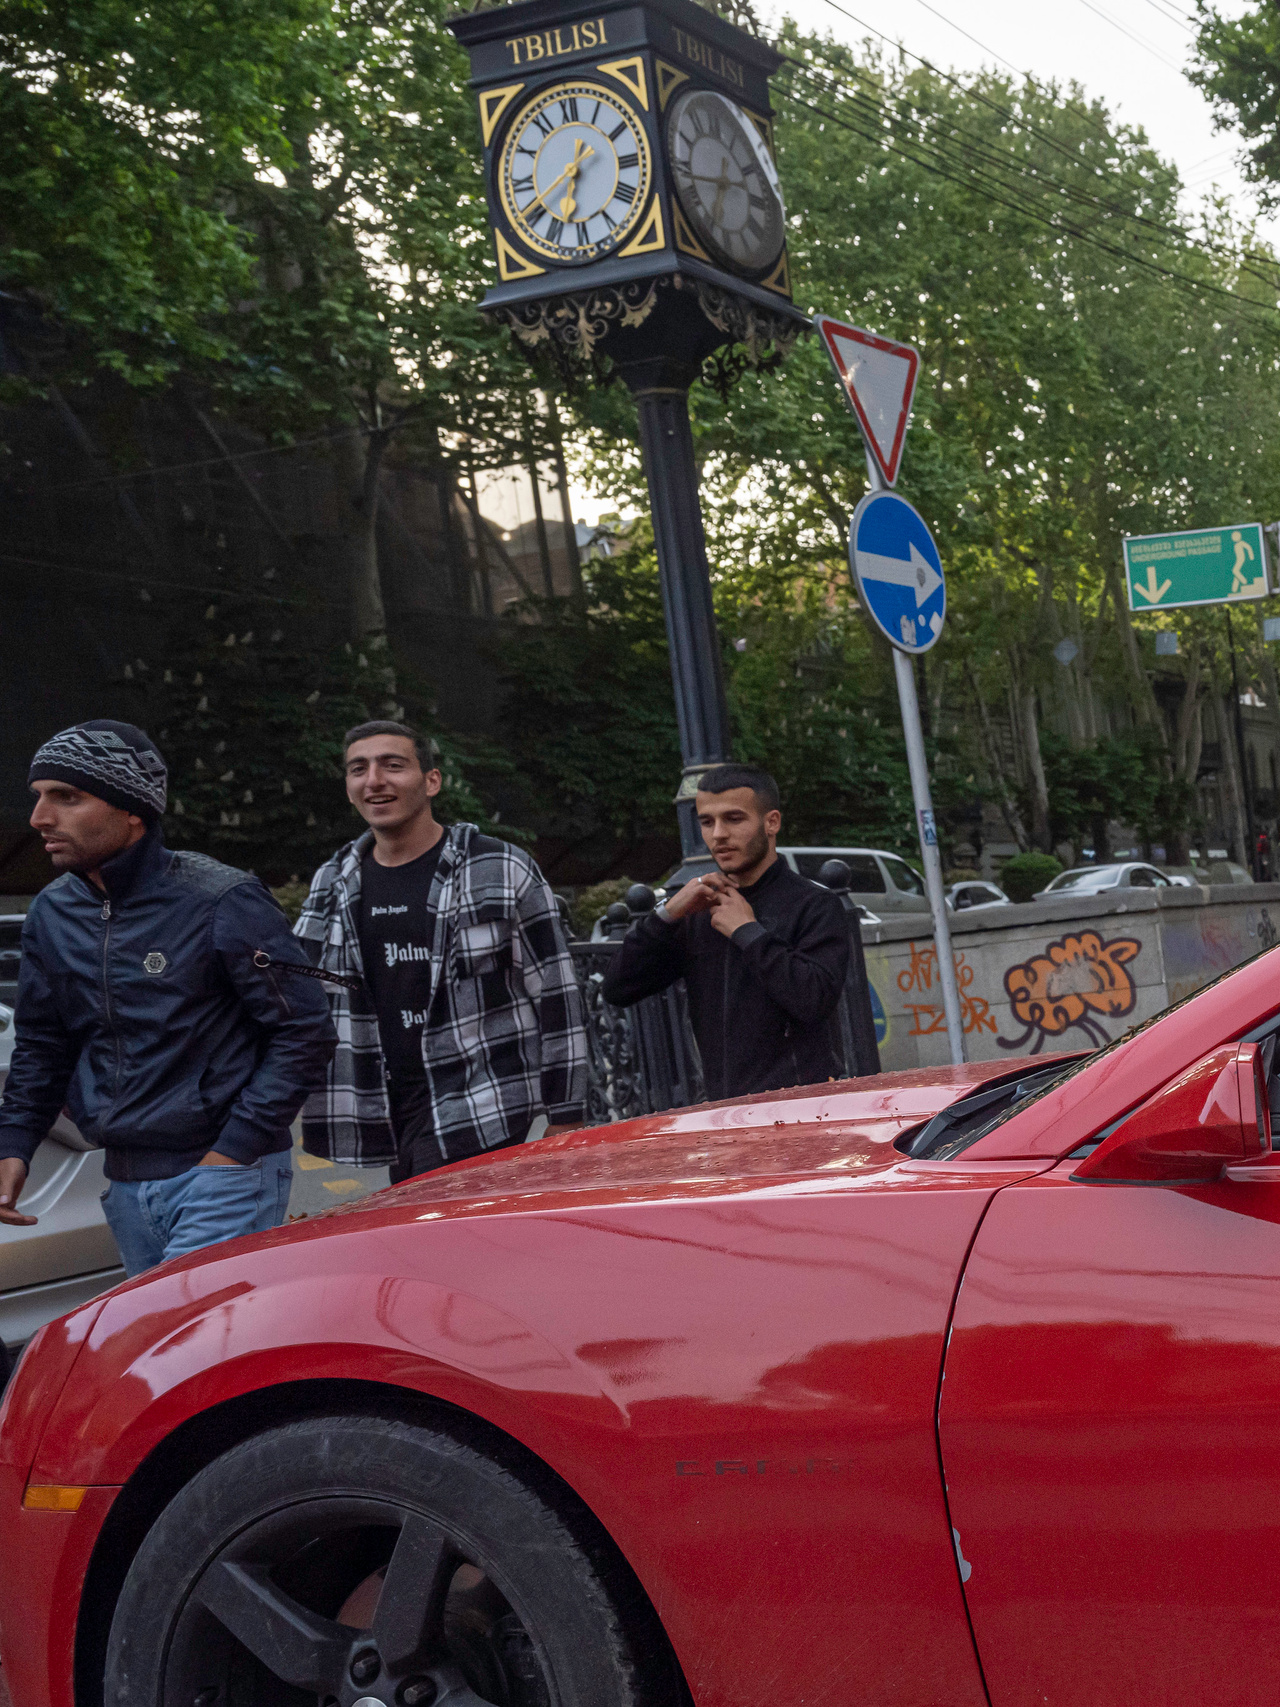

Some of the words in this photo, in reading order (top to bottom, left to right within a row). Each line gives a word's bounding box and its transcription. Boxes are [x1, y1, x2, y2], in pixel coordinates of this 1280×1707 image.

[506, 18, 608, 65] TBILISI
[672, 26, 744, 88] TBILISI
[371, 906, 387, 916] Palm
[388, 905, 408, 915] Angels
[384, 942, 430, 967] Palm
[400, 1008, 428, 1029] Pal
